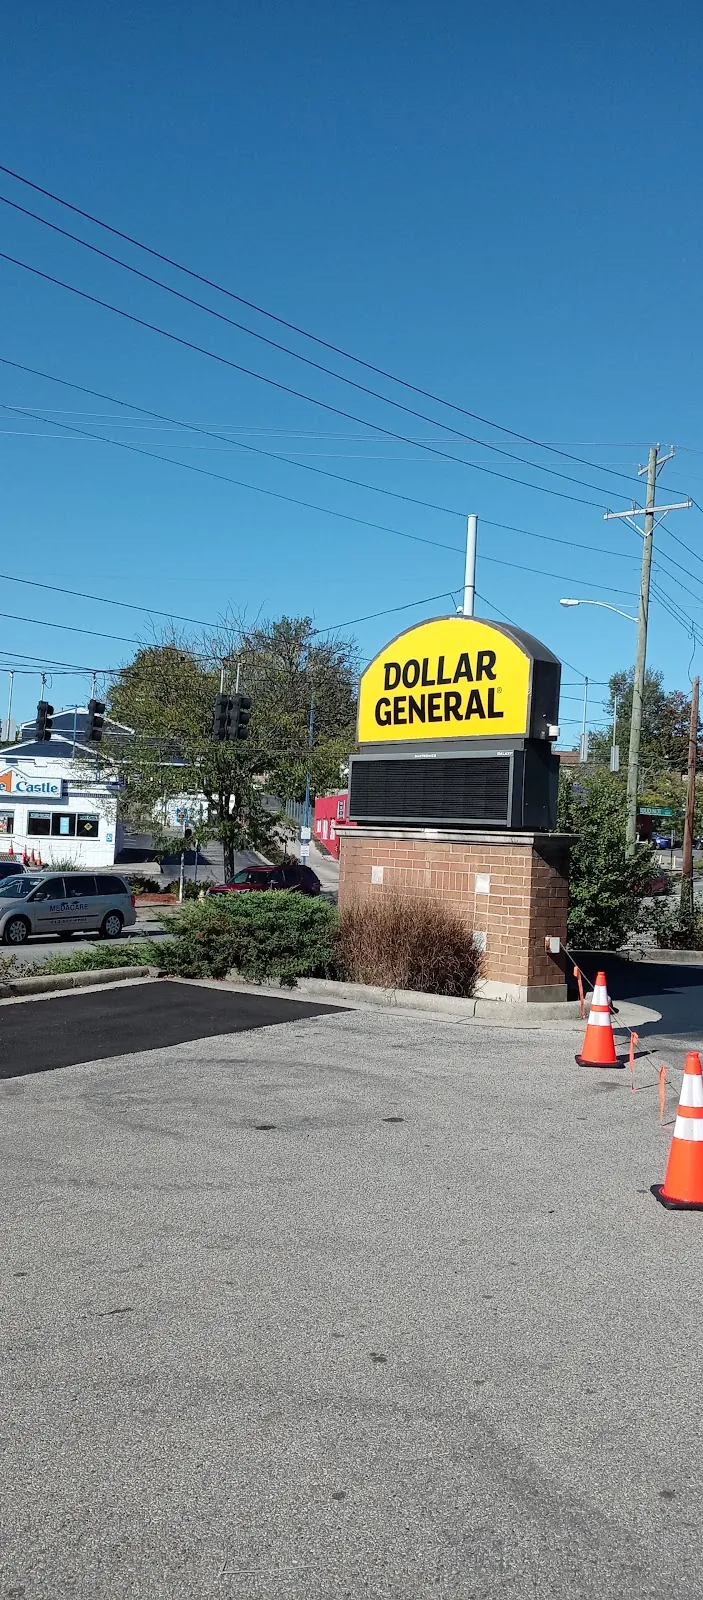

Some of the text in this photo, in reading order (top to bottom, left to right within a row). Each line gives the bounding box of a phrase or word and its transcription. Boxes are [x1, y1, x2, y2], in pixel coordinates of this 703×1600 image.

[384, 650, 496, 691] DOLLAR
[375, 687, 503, 726] GENERAL
[16, 781, 58, 793] Castle
[49, 903, 88, 912] MEDACARE
